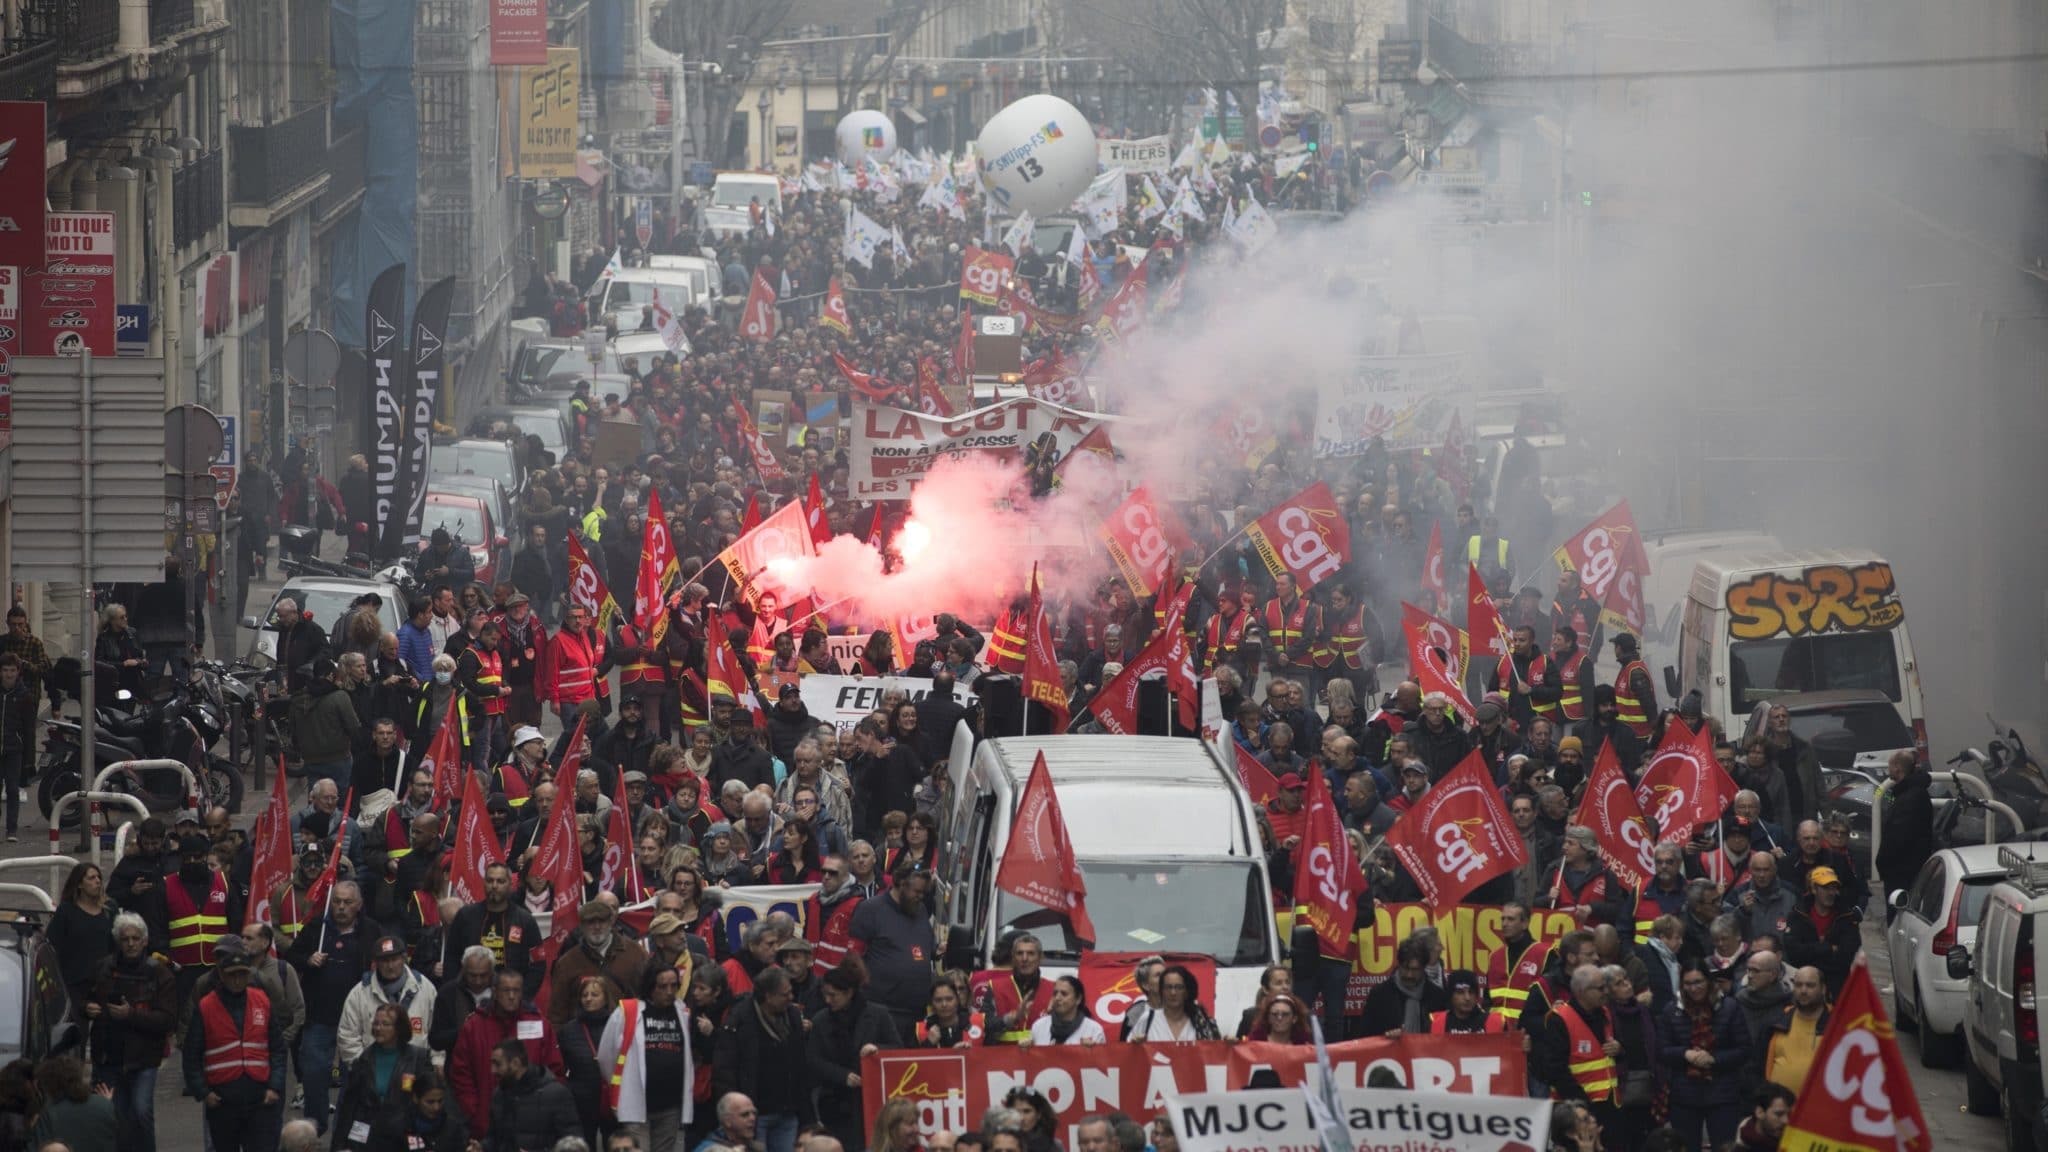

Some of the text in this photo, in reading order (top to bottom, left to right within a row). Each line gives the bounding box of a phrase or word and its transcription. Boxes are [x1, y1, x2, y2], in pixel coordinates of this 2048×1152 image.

[499, 8, 537, 16] FACADES
[1110, 144, 1166, 161] THIERS
[1016, 157, 1044, 184] 13
[965, 264, 1010, 293] cgt
[865, 409, 925, 440] LA
[872, 446, 910, 457] NON
[963, 435, 1018, 447] CASSE
[858, 480, 898, 494] LES
[1258, 507, 1342, 583] cgt
[1434, 822, 1490, 883] cgt
[986, 1066, 1121, 1114] NON
[1143, 1050, 1179, 1111] À
[1183, 1101, 1288, 1140] MJC
